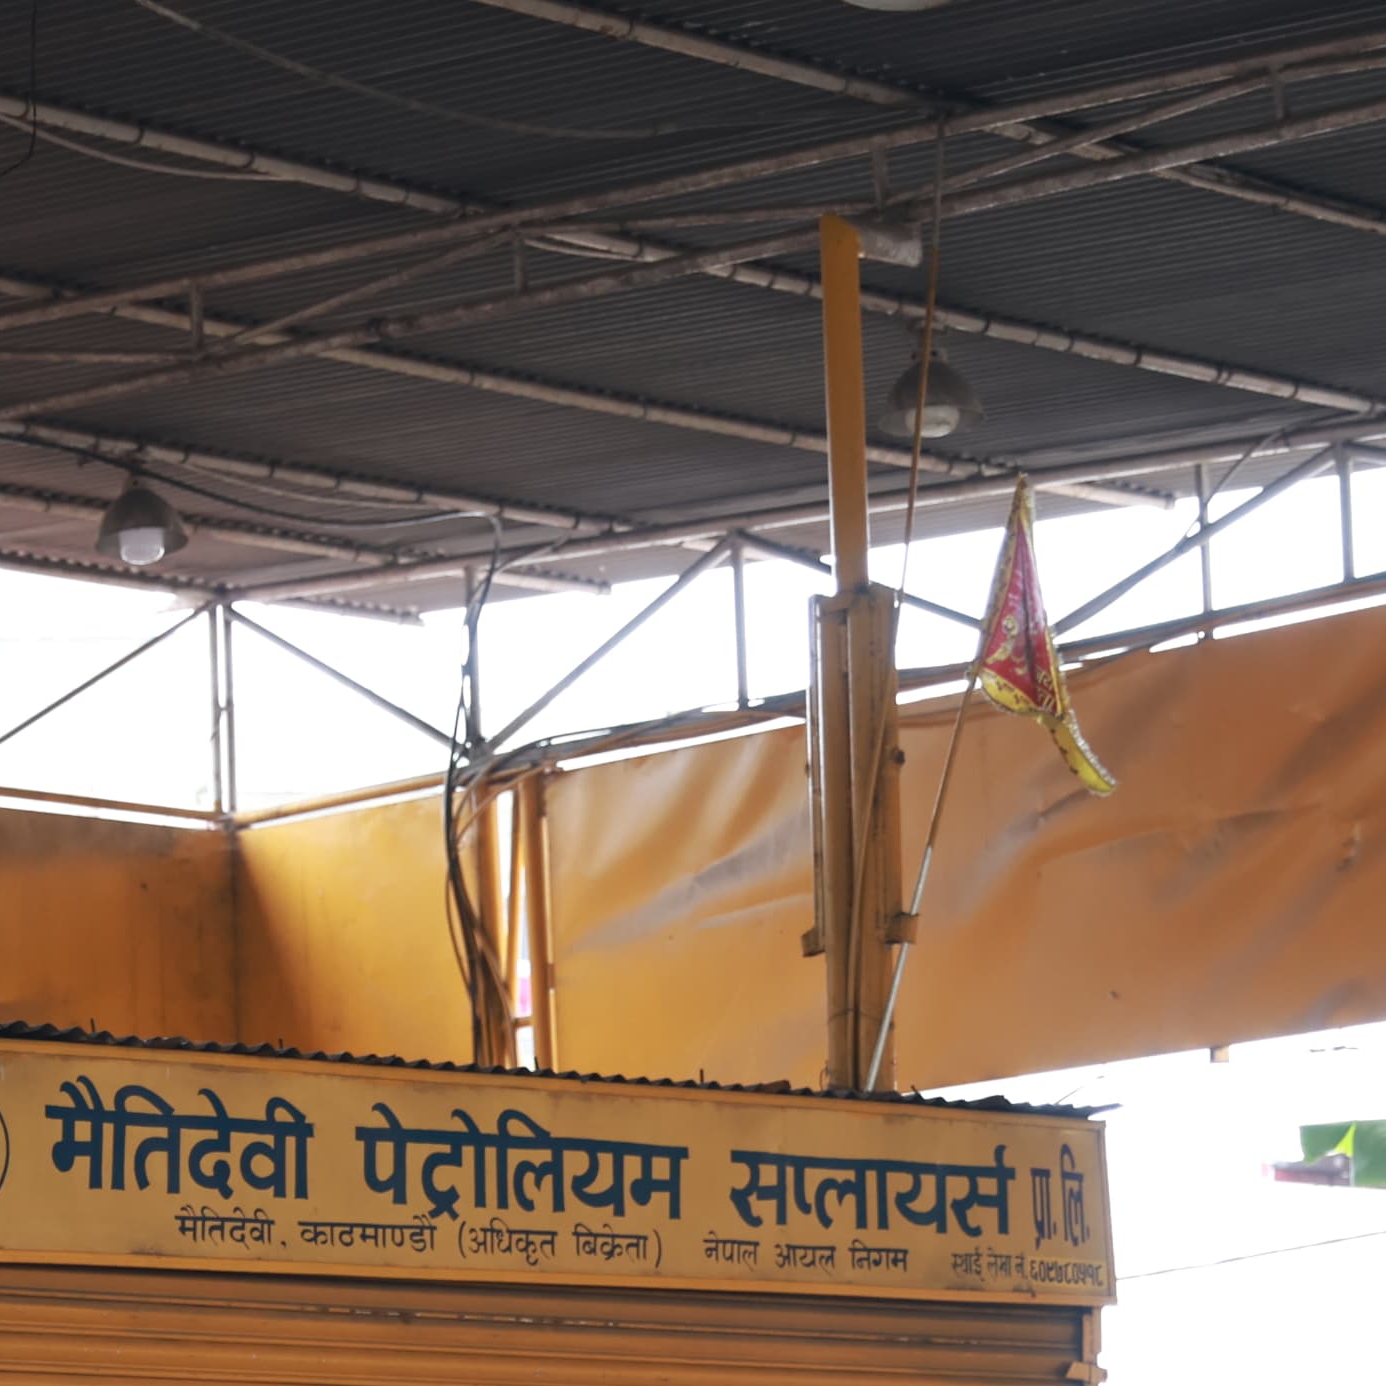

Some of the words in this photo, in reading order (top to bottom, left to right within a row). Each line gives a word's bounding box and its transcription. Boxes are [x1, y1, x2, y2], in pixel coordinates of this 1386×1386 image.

[45, 1075, 314, 1200] मैतिदेवी
[355, 1102, 689, 1221] पेट्रोलियम
[730, 1145, 1016, 1237] सप्लायर्स
[702, 1230, 761, 1273] नेपाल
[775, 1243, 837, 1275] आयल
[848, 1238, 910, 1273] निगम
